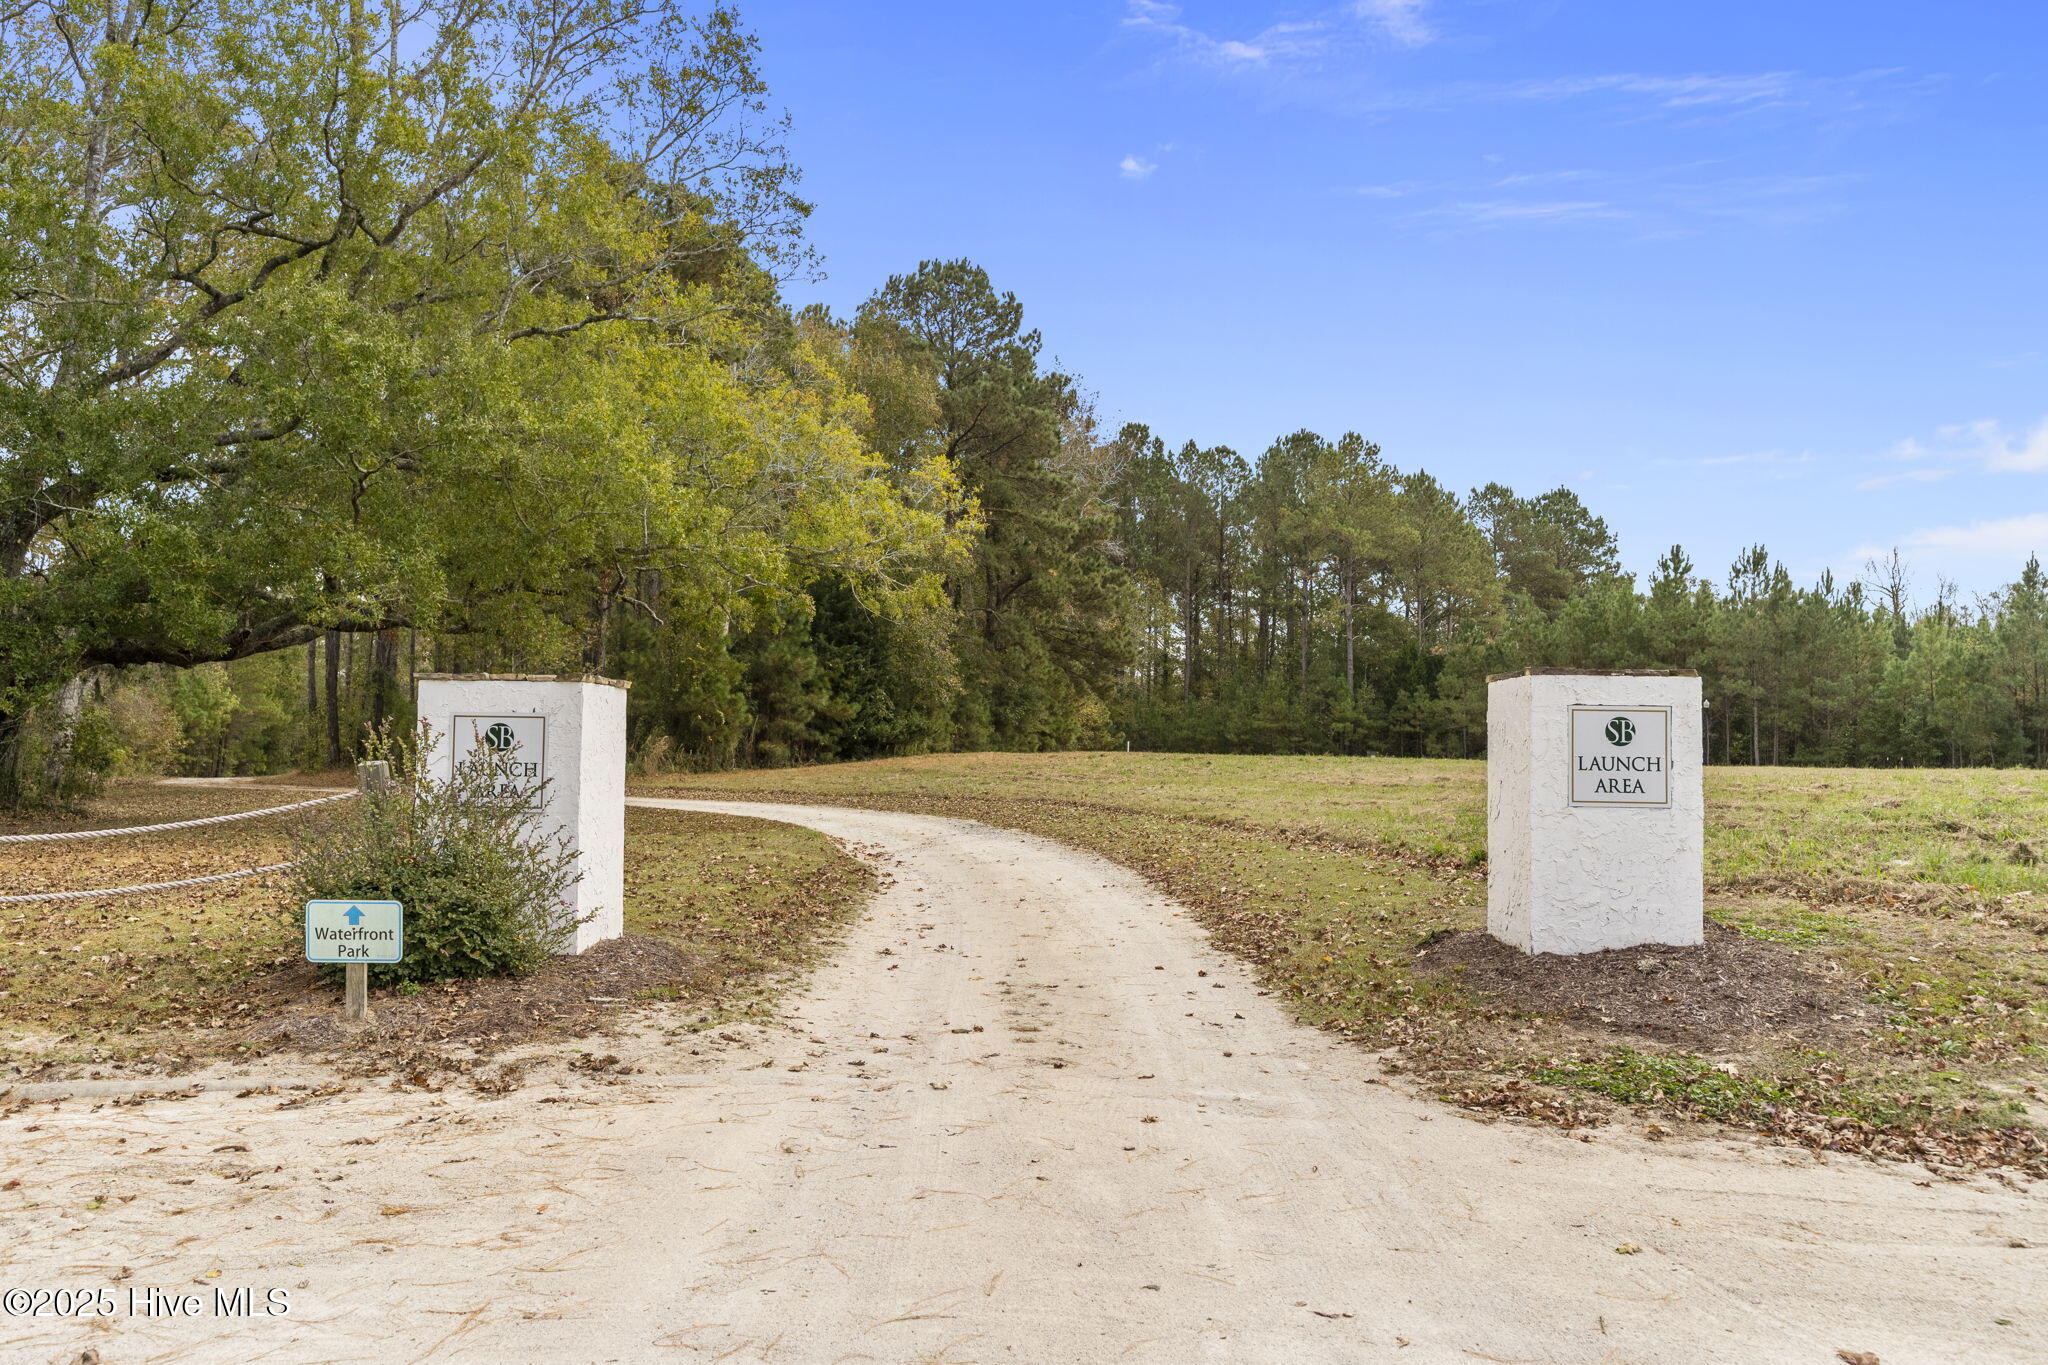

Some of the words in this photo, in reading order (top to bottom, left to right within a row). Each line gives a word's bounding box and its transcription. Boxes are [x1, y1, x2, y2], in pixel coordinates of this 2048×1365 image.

[1605, 719, 1635, 743] SB
[1578, 755, 1661, 772] LAUNCH
[1594, 778, 1645, 793] AREA
[314, 927, 394, 940] Waterfront
[338, 944, 369, 957] Park
